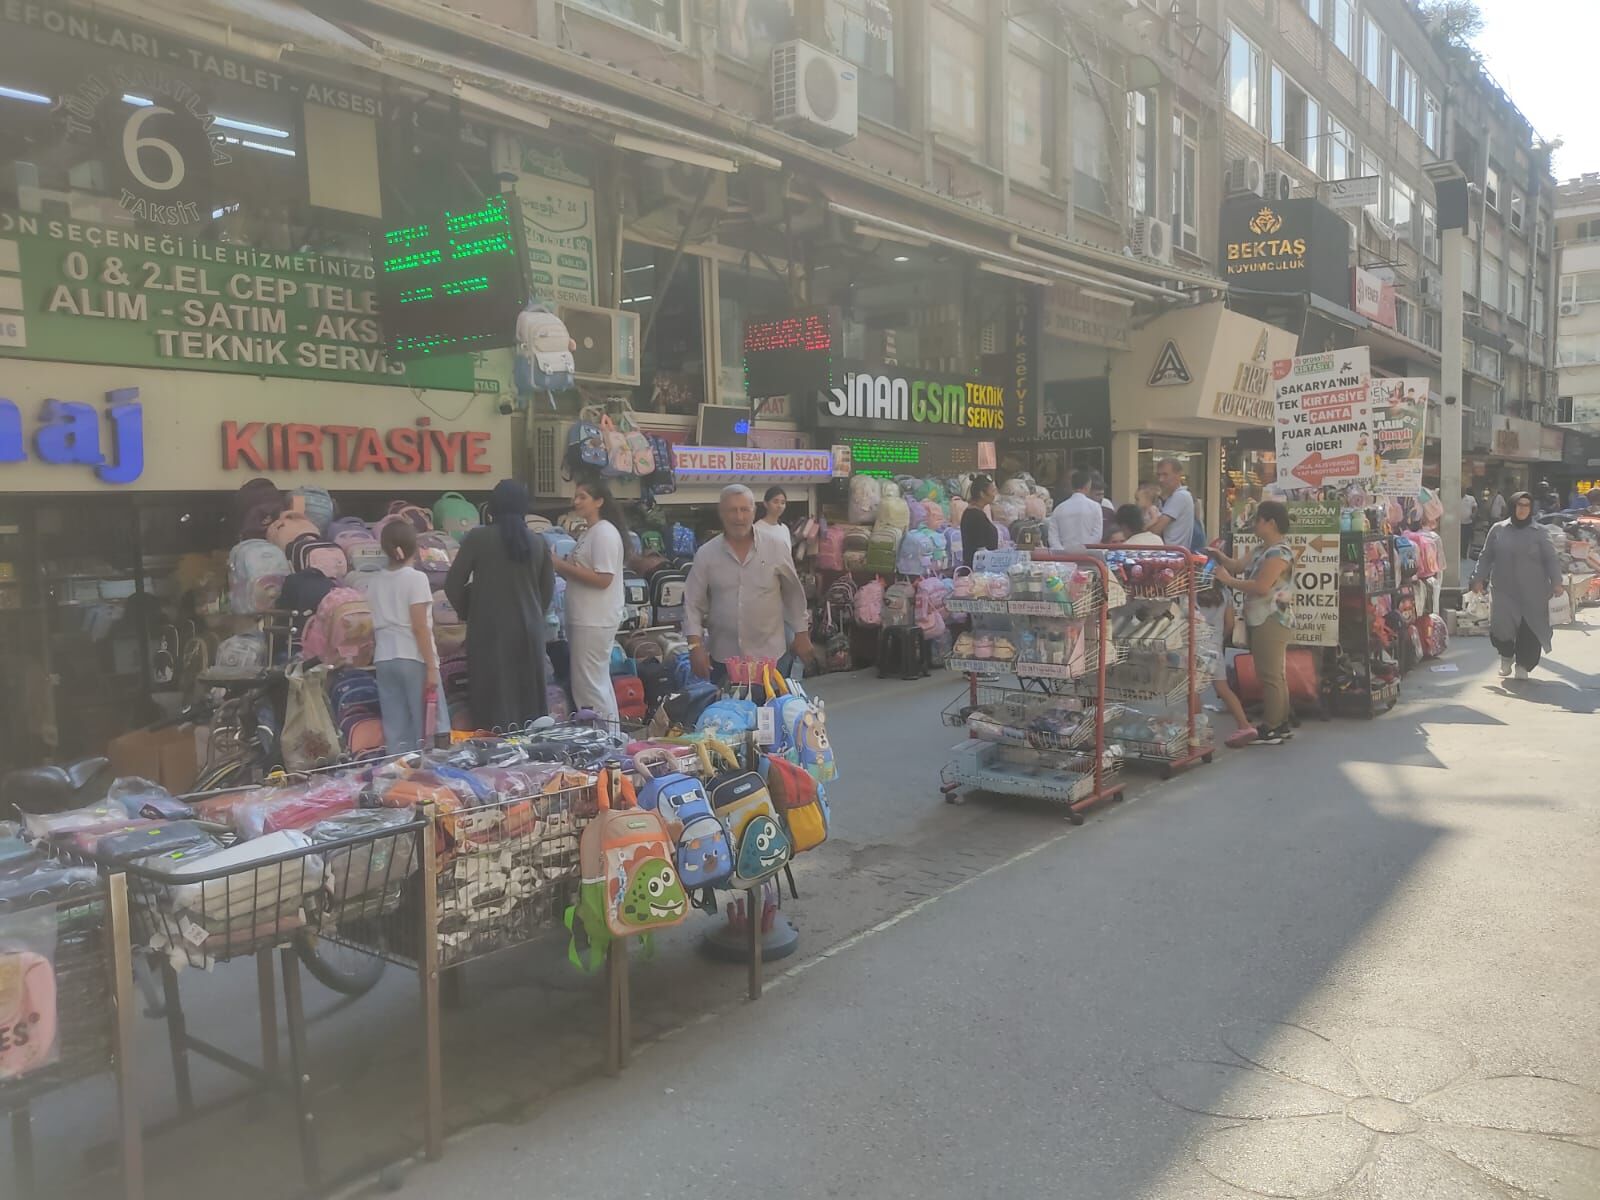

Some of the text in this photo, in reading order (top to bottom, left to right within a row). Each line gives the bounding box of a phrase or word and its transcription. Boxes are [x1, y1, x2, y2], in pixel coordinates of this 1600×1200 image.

[5, 0, 159, 58] EFONLARI
[187, 48, 282, 91] TABLET
[123, 106, 185, 190] 6
[118, 188, 200, 226] TAKSİT
[49, 220, 183, 257] SEÇENEĞİ
[192, 239, 227, 263] İLE
[235, 249, 376, 280] HİZMETİNİZD
[1227, 239, 1306, 262] BEKTAŞ
[65, 251, 90, 281] 0
[103, 260, 131, 288] &
[229, 273, 298, 304] CEP
[305, 282, 380, 315] TELE
[49, 285, 148, 321] ALIM
[183, 297, 287, 335] SATIM
[314, 316, 379, 344] AKS
[155, 329, 288, 366] TEKNİK
[965, 381, 1004, 408] TEKNİK
[1281, 376, 1359, 396] SAKARYA'NIN
[911, 380, 966, 425] GSM
[1214, 392, 1275, 421] KUYUMCULU
[1278, 400, 1299, 411] TEK
[1303, 390, 1365, 407] KIRTASİYE
[967, 406, 1004, 430] SERVİS
[1294, 408, 1351, 423] VE ÇANTA
[1282, 422, 1367, 440] FUAR ALANINA
[221, 416, 493, 475] KIRTASİYE
[1306, 440, 1342, 452] GİDER!
[770, 455, 829, 471] KUAFÖRÜ
[1295, 535, 1307, 545] EN
[1296, 592, 1339, 607] RKEZİ
[1316, 624, 1327, 632] VE
[1320, 613, 1338, 621] Web
